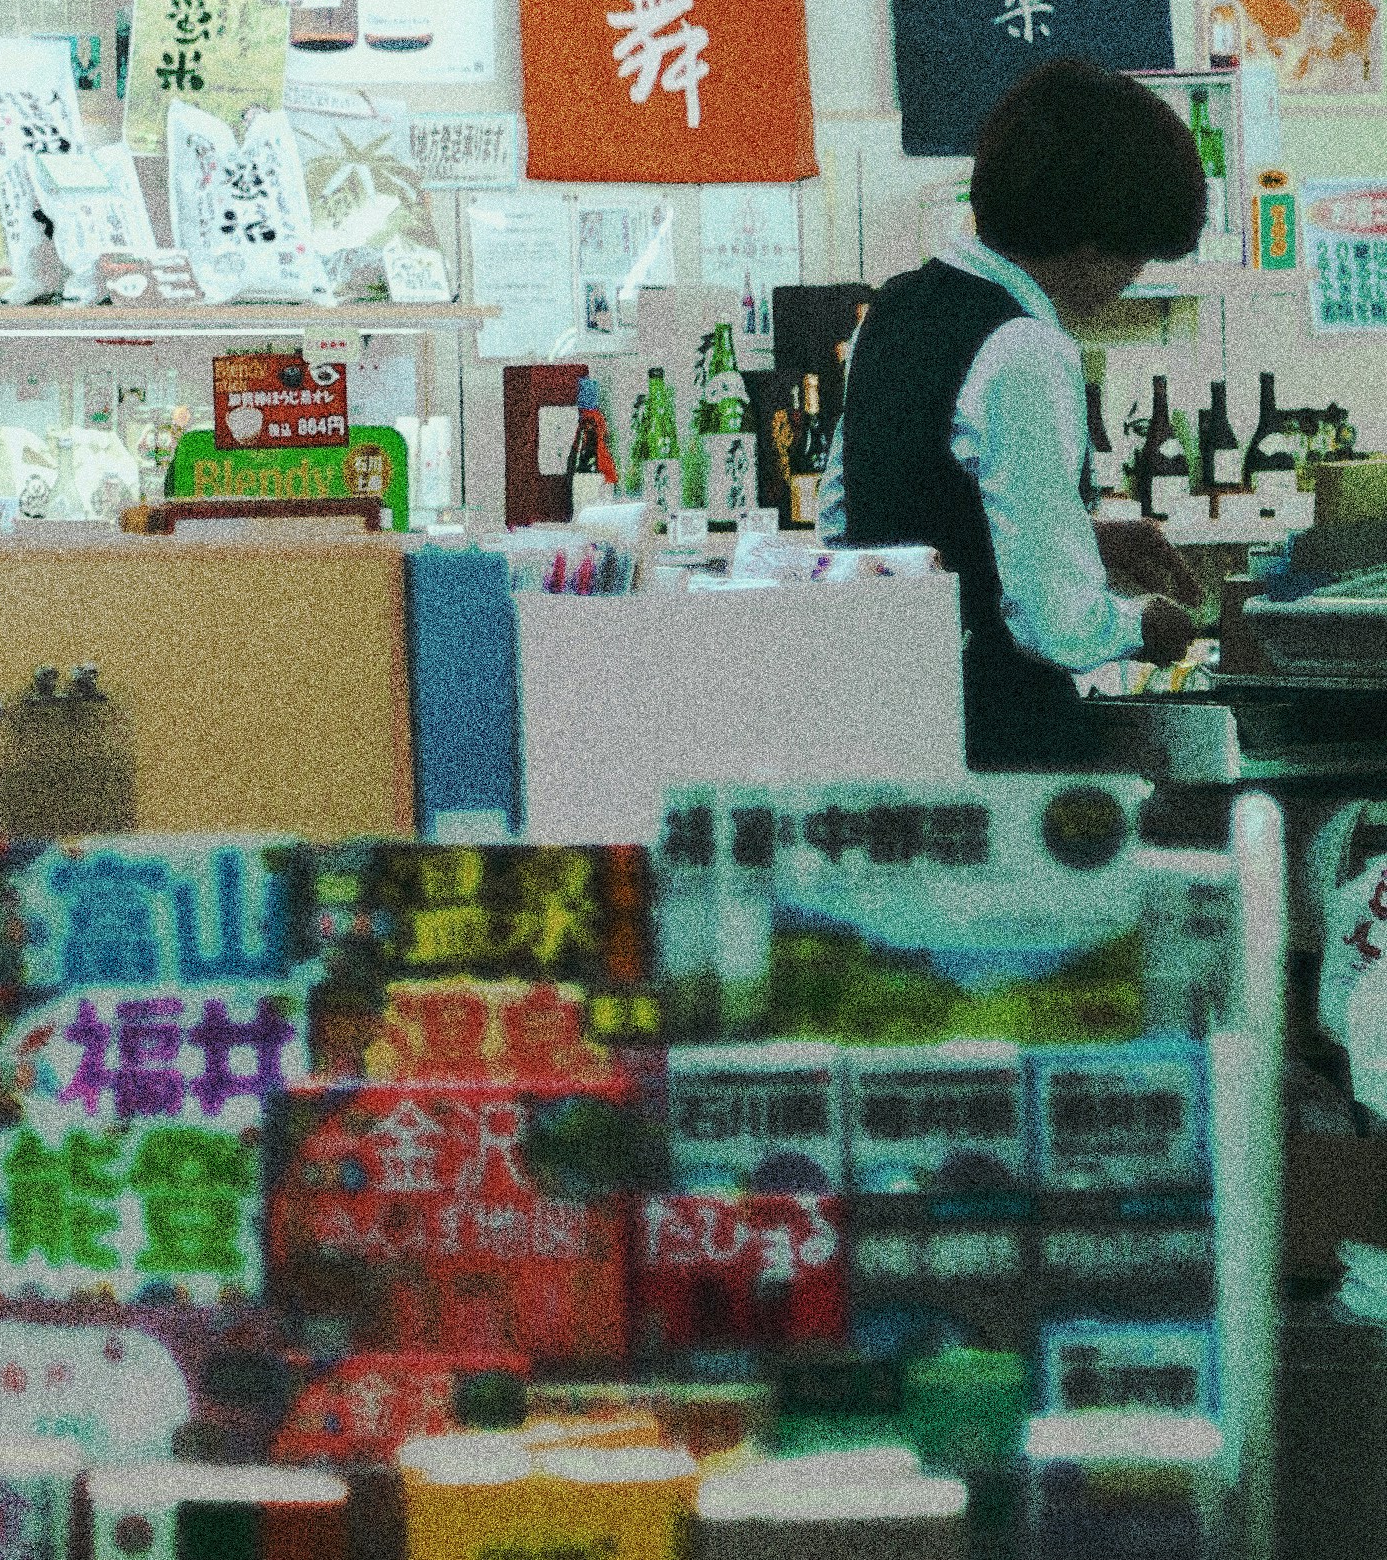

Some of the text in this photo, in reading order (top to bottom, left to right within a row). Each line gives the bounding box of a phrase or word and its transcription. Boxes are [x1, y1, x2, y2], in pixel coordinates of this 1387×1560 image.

[193, 460, 339, 499] Blendy
[60, 994, 297, 1117] 福井
[3, 1125, 257, 1273] 能登
[369, 1099, 535, 1194] 金沢
